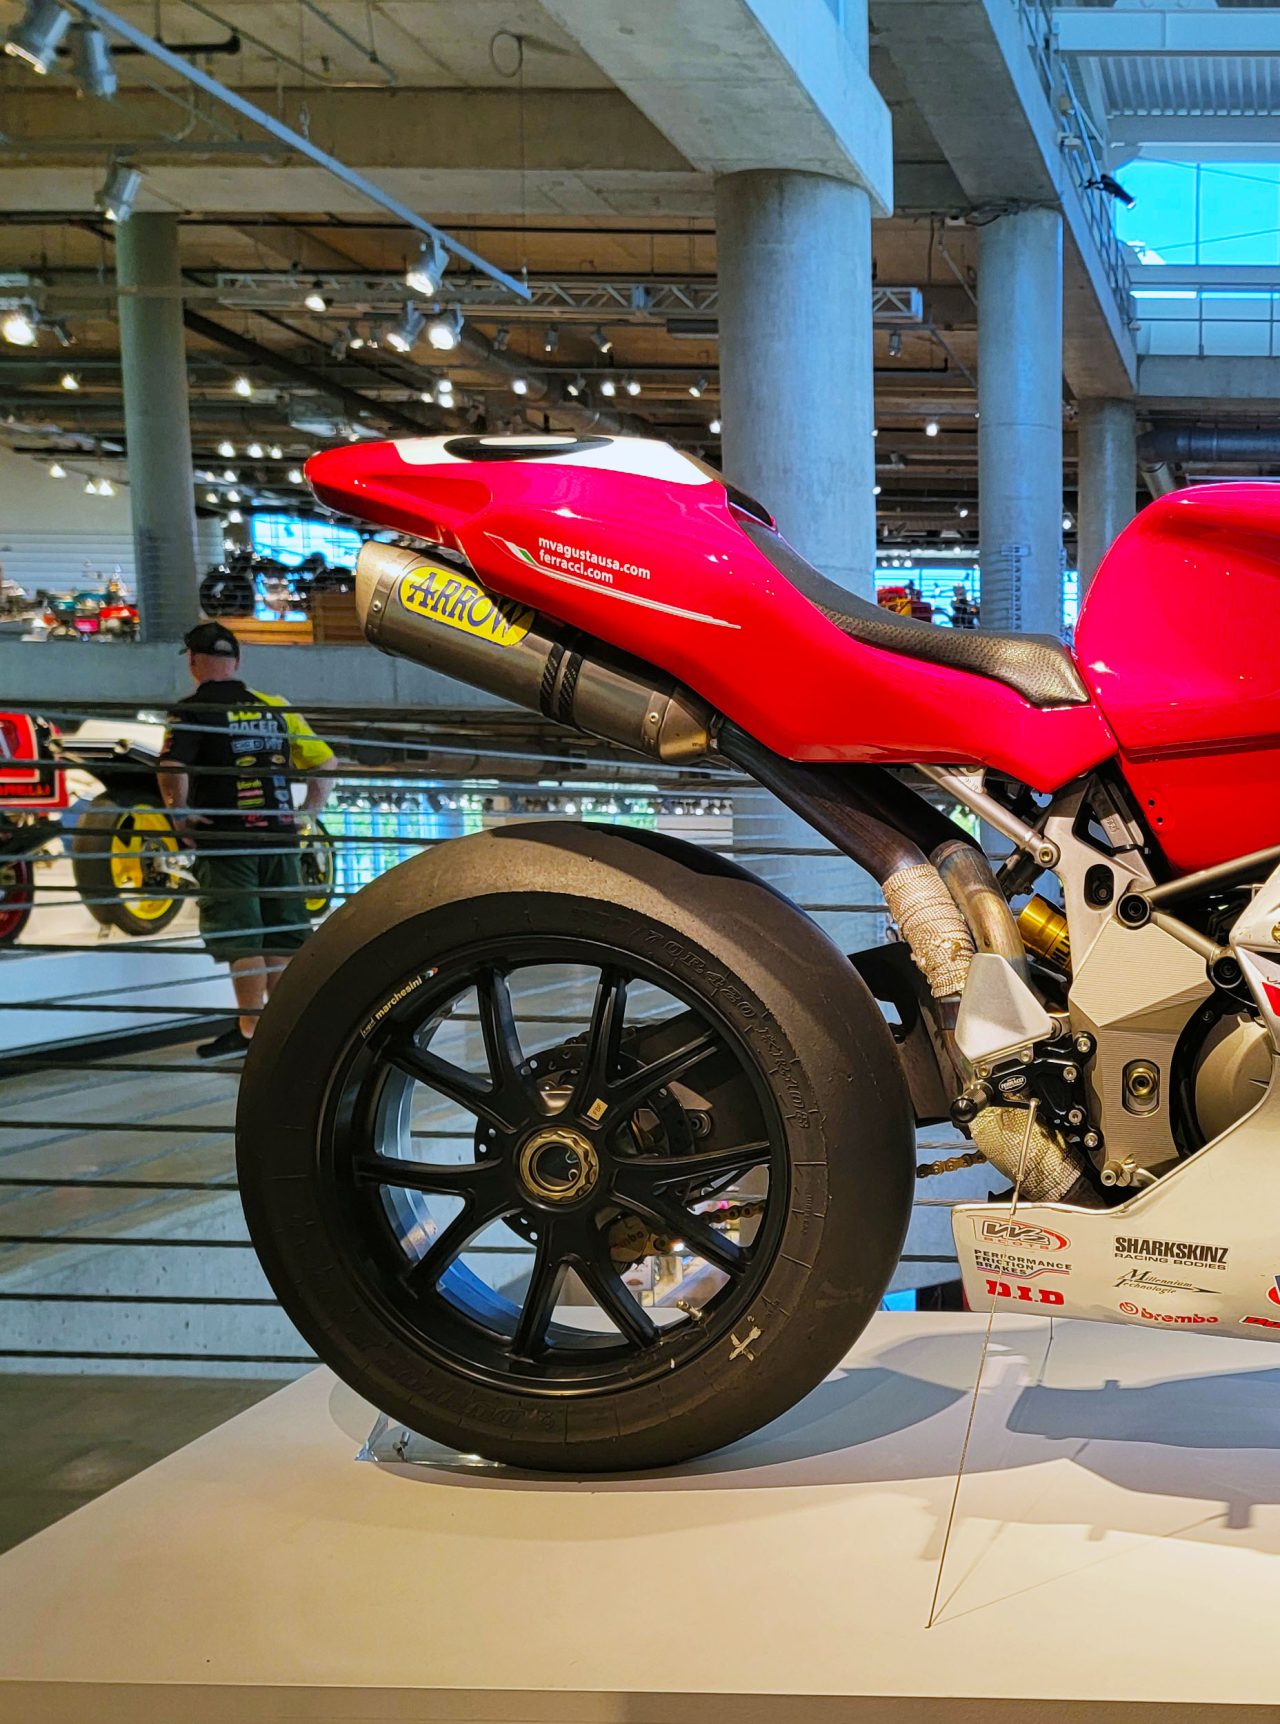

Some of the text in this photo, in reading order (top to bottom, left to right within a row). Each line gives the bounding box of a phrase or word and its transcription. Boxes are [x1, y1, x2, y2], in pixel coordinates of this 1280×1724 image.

[538, 536, 651, 580] mvagustausa.com
[539, 549, 614, 584] ferracci.com
[407, 571, 528, 639] ARROW
[374, 975, 423, 1021] marchesini
[974, 1249, 1073, 1270] PERFORMANCE
[974, 1255, 1034, 1271] FRICTION
[1114, 1252, 1227, 1271] RACING BODIES
[1115, 1236, 1229, 1264] SHARKSKINZ
[975, 1261, 1027, 1275] BRAKES
[985, 1279, 1065, 1305] D.I.D
[1141, 1307, 1219, 1324] brembo
